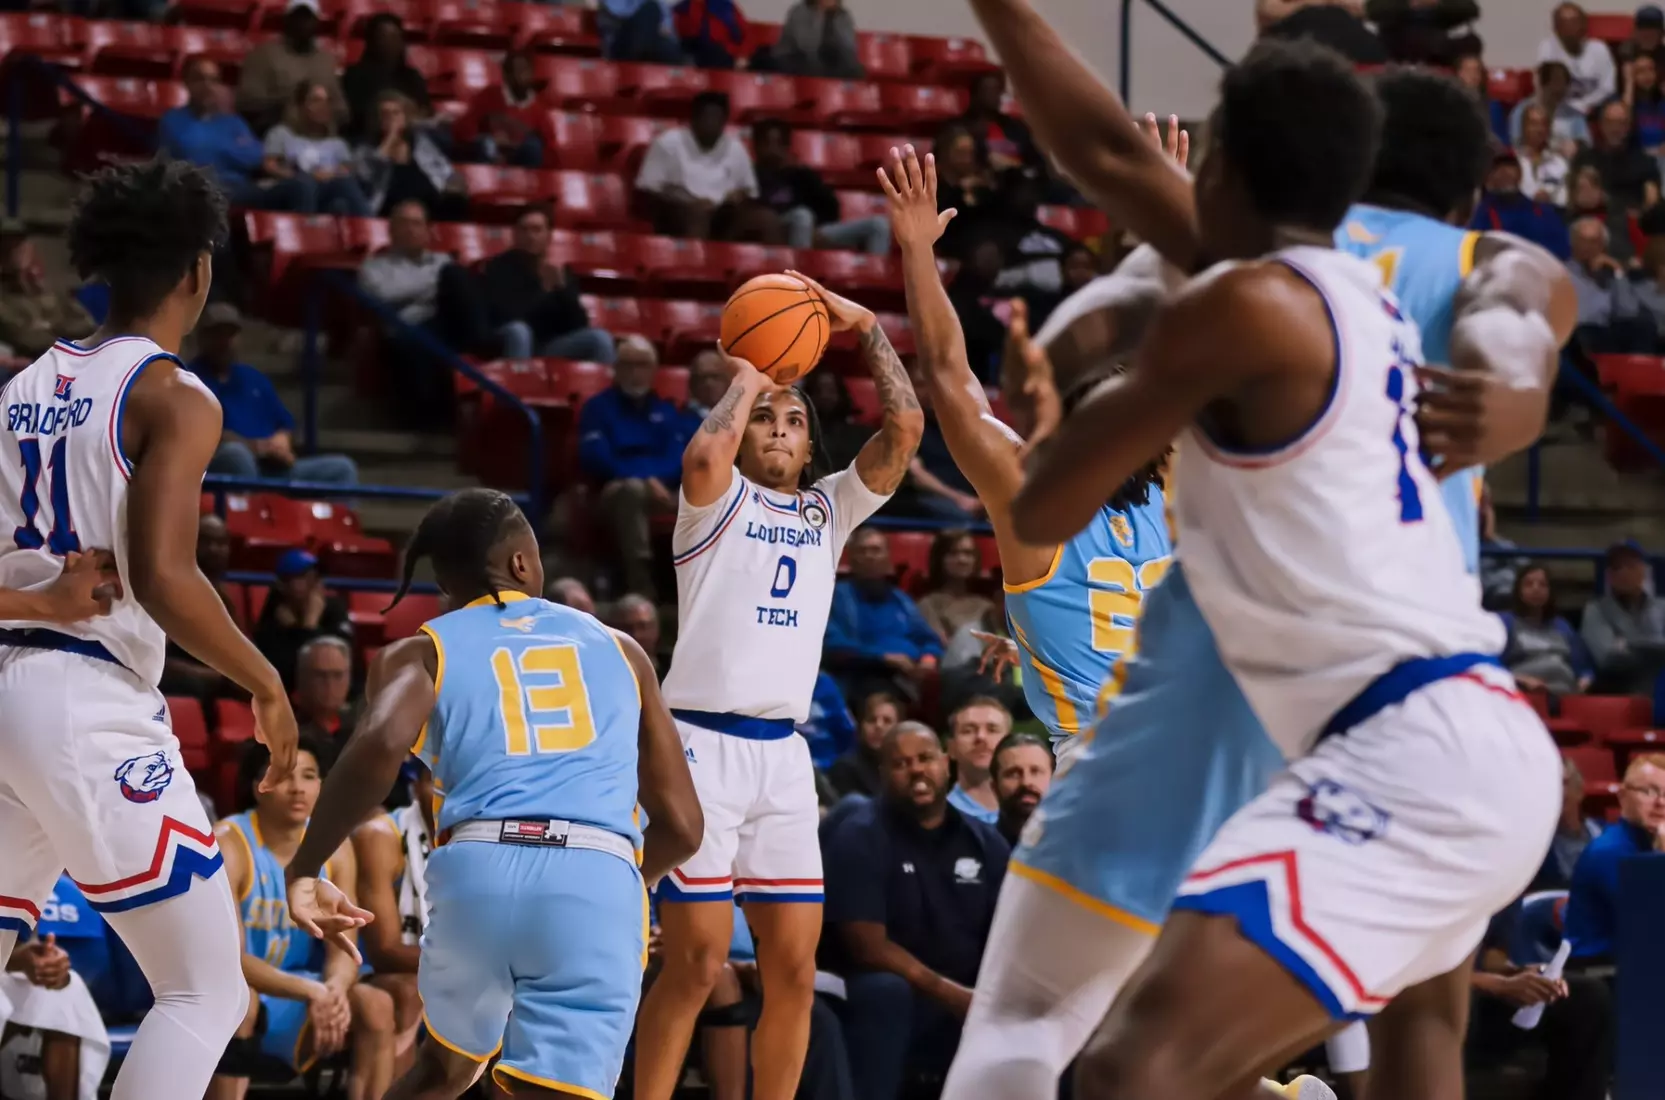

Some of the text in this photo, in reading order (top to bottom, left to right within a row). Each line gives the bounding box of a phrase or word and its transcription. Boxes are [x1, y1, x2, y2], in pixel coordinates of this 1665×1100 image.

[13, 436, 82, 556] 11
[770, 555, 796, 598] 0
[757, 606, 798, 627] TECH
[490, 643, 597, 756] 13
